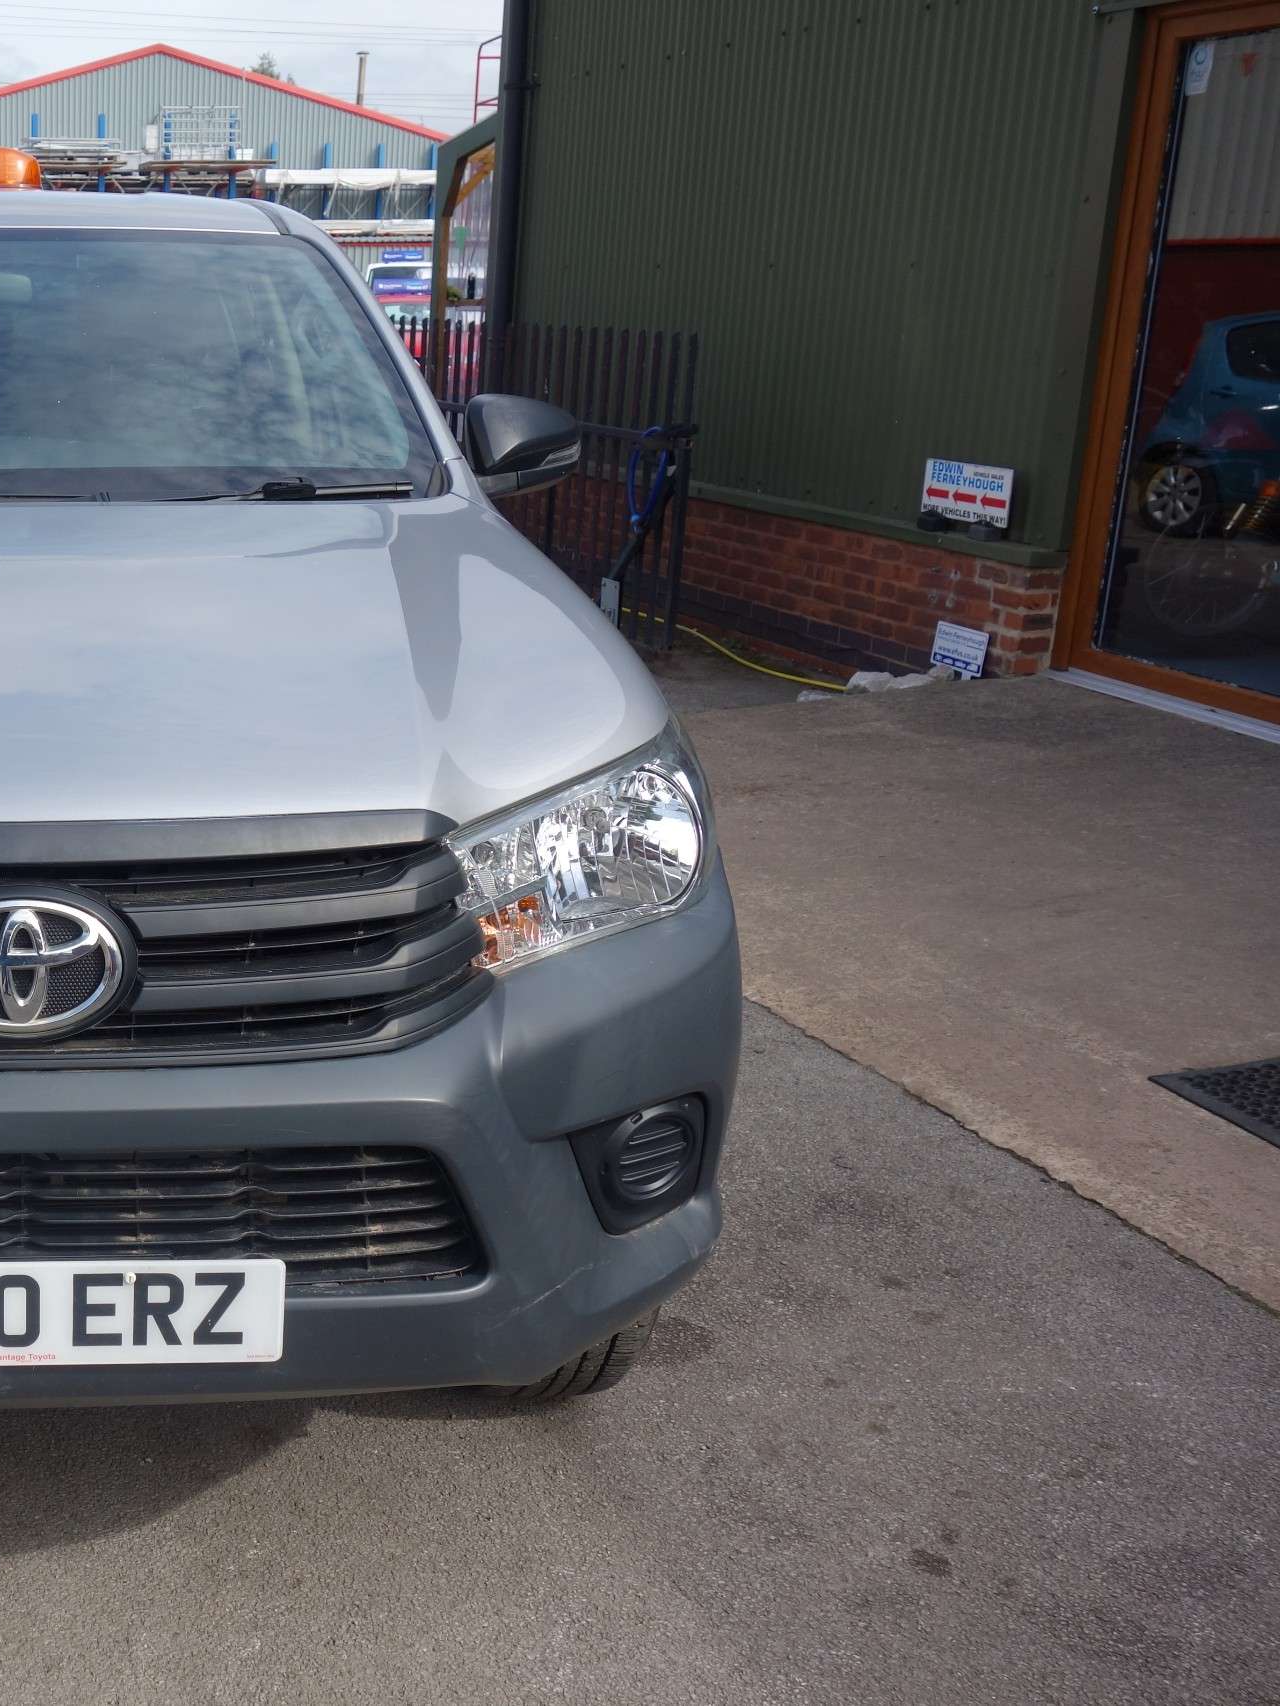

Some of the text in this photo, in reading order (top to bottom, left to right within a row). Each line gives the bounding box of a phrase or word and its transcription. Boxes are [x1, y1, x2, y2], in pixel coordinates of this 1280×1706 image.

[932, 461, 964, 475] EDWIN
[931, 472, 1004, 492] FERNEYHOUGH
[941, 506, 971, 518] VEHICLES
[72, 1272, 246, 1347] ERZ
[29, 1353, 57, 1361] Toyota
